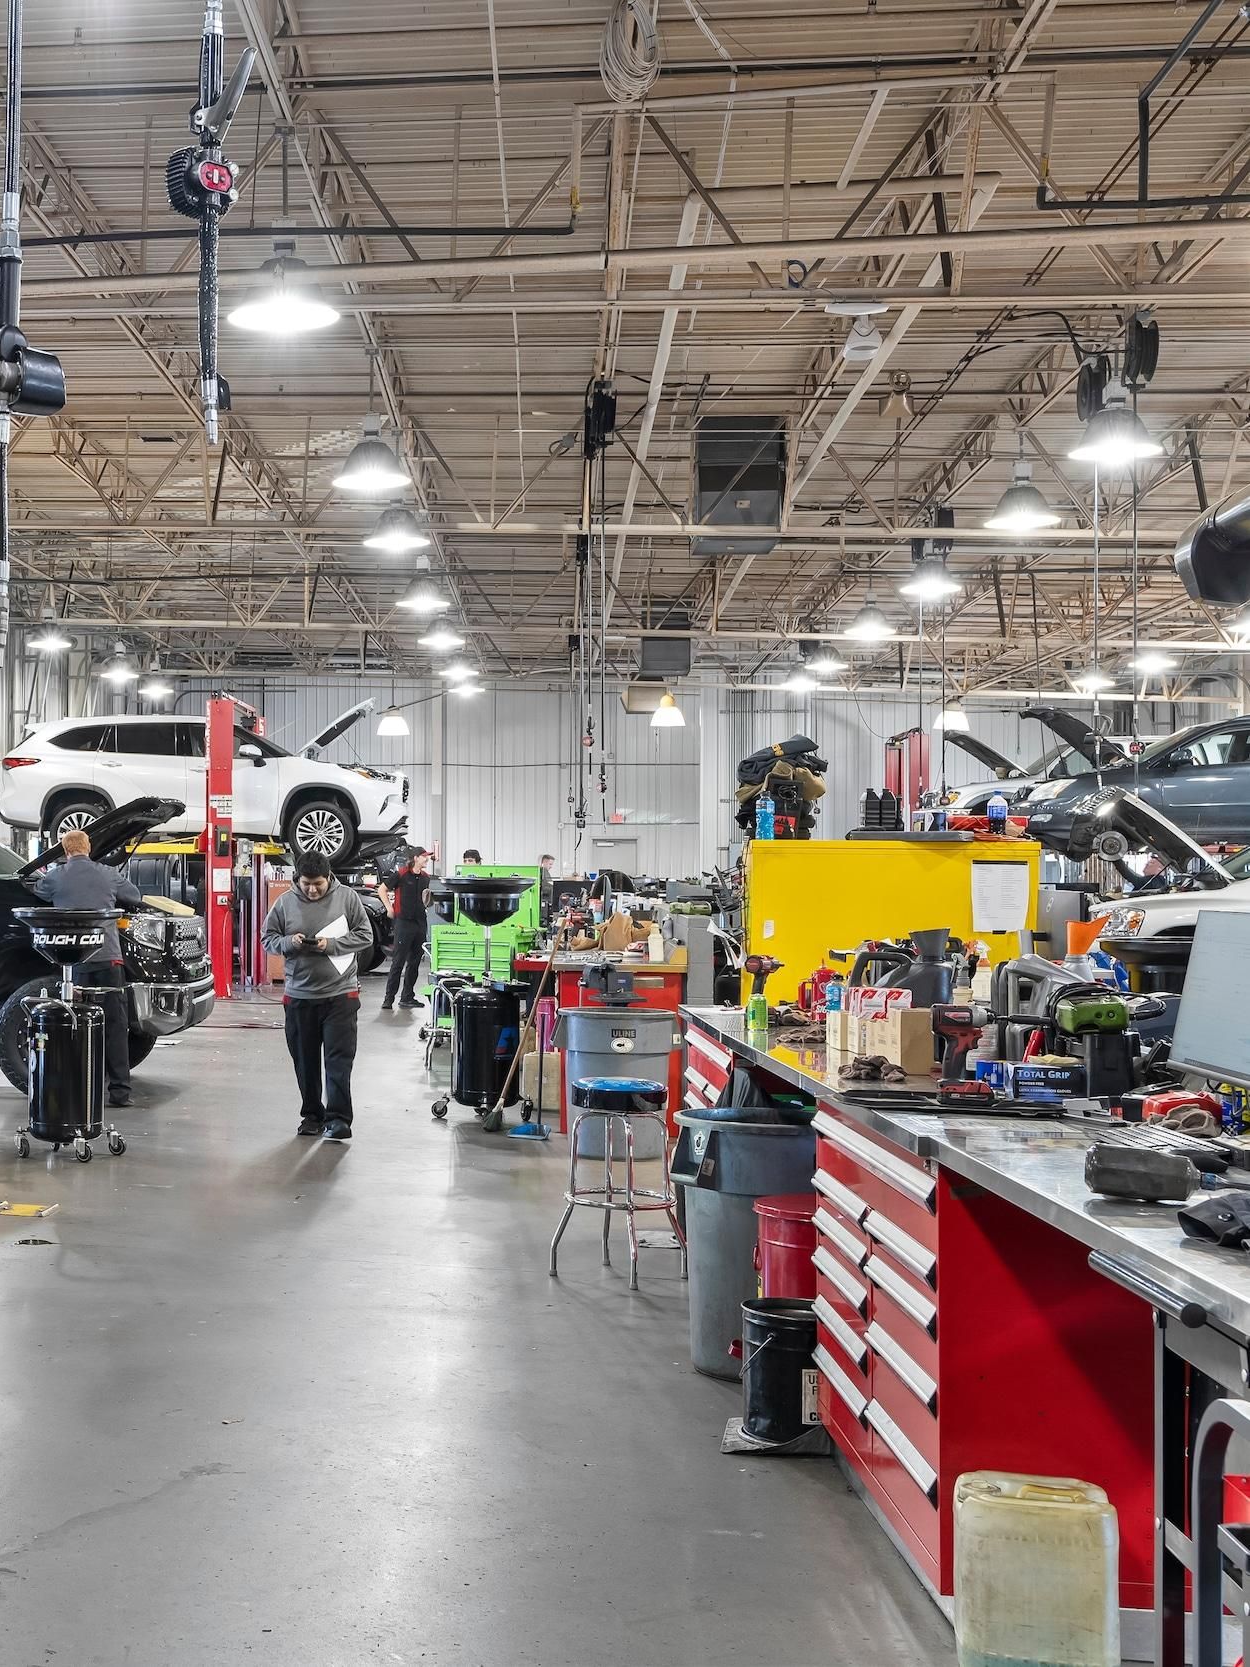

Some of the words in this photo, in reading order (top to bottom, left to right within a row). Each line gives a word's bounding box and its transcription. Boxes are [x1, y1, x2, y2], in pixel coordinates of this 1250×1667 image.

[33, 934, 77, 945] ROUGH
[613, 1030, 636, 1038] ULINE
[1017, 1070, 1046, 1078] TOTAL
[1048, 1071, 1070, 1079] GRIP
